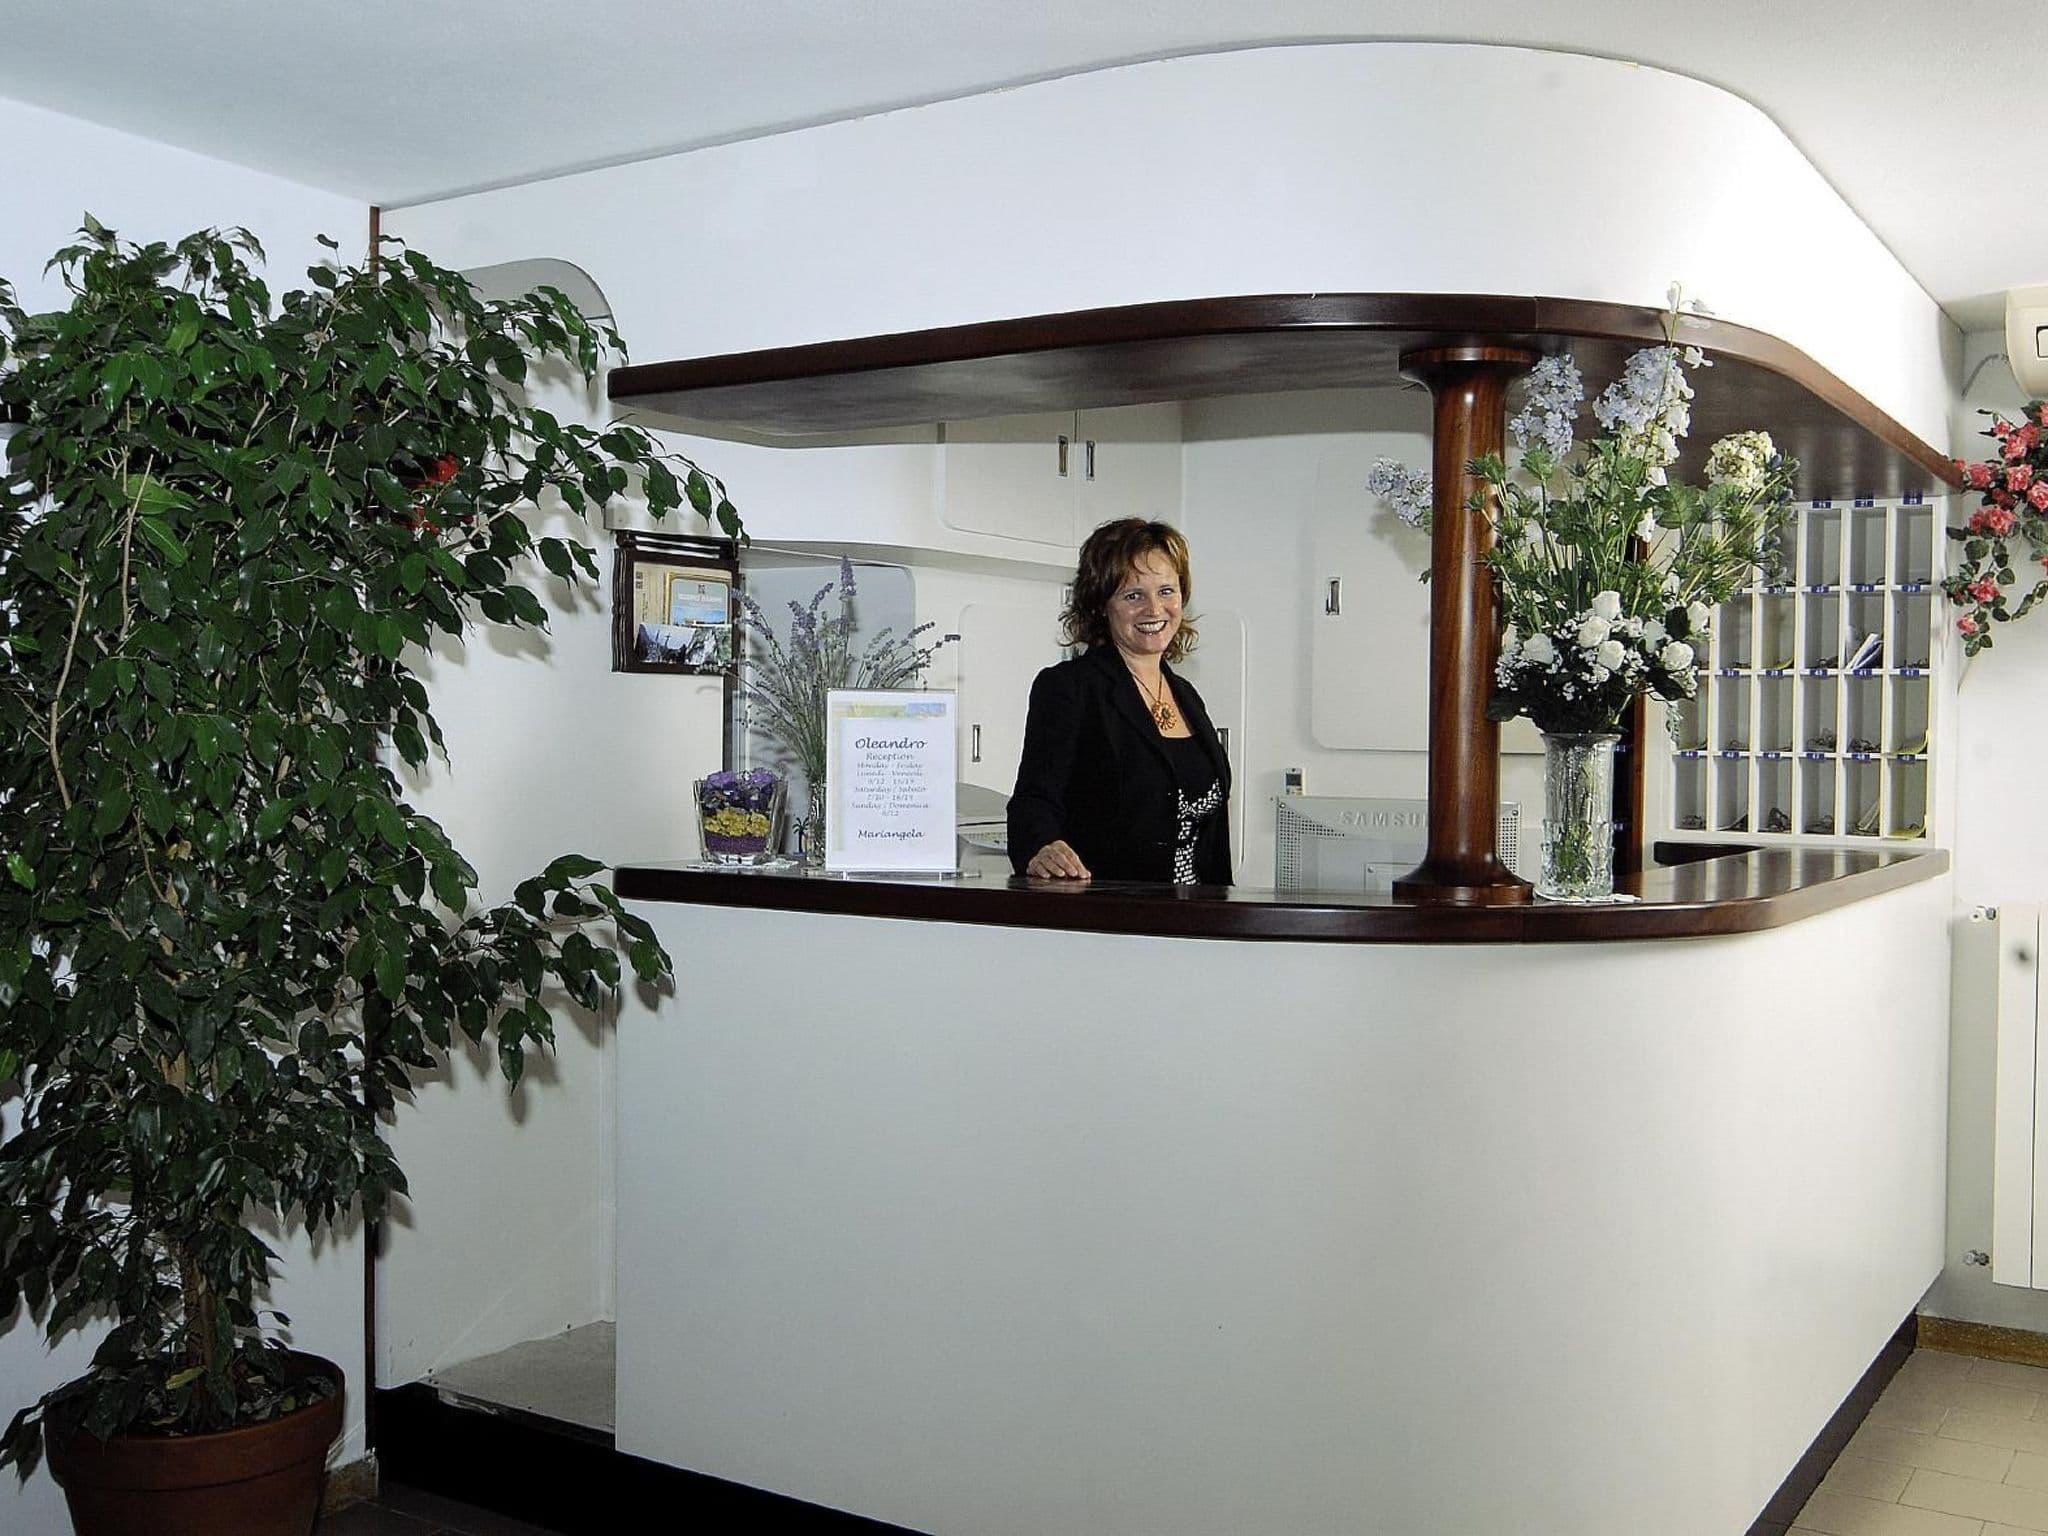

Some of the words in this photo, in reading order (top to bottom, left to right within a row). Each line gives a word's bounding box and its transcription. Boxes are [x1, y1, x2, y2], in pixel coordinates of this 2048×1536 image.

[855, 737, 928, 749] Oleandro
[866, 753, 914, 761] Reception
[1340, 811, 1429, 827] SAMSU
[858, 829, 925, 840] Mariangela
